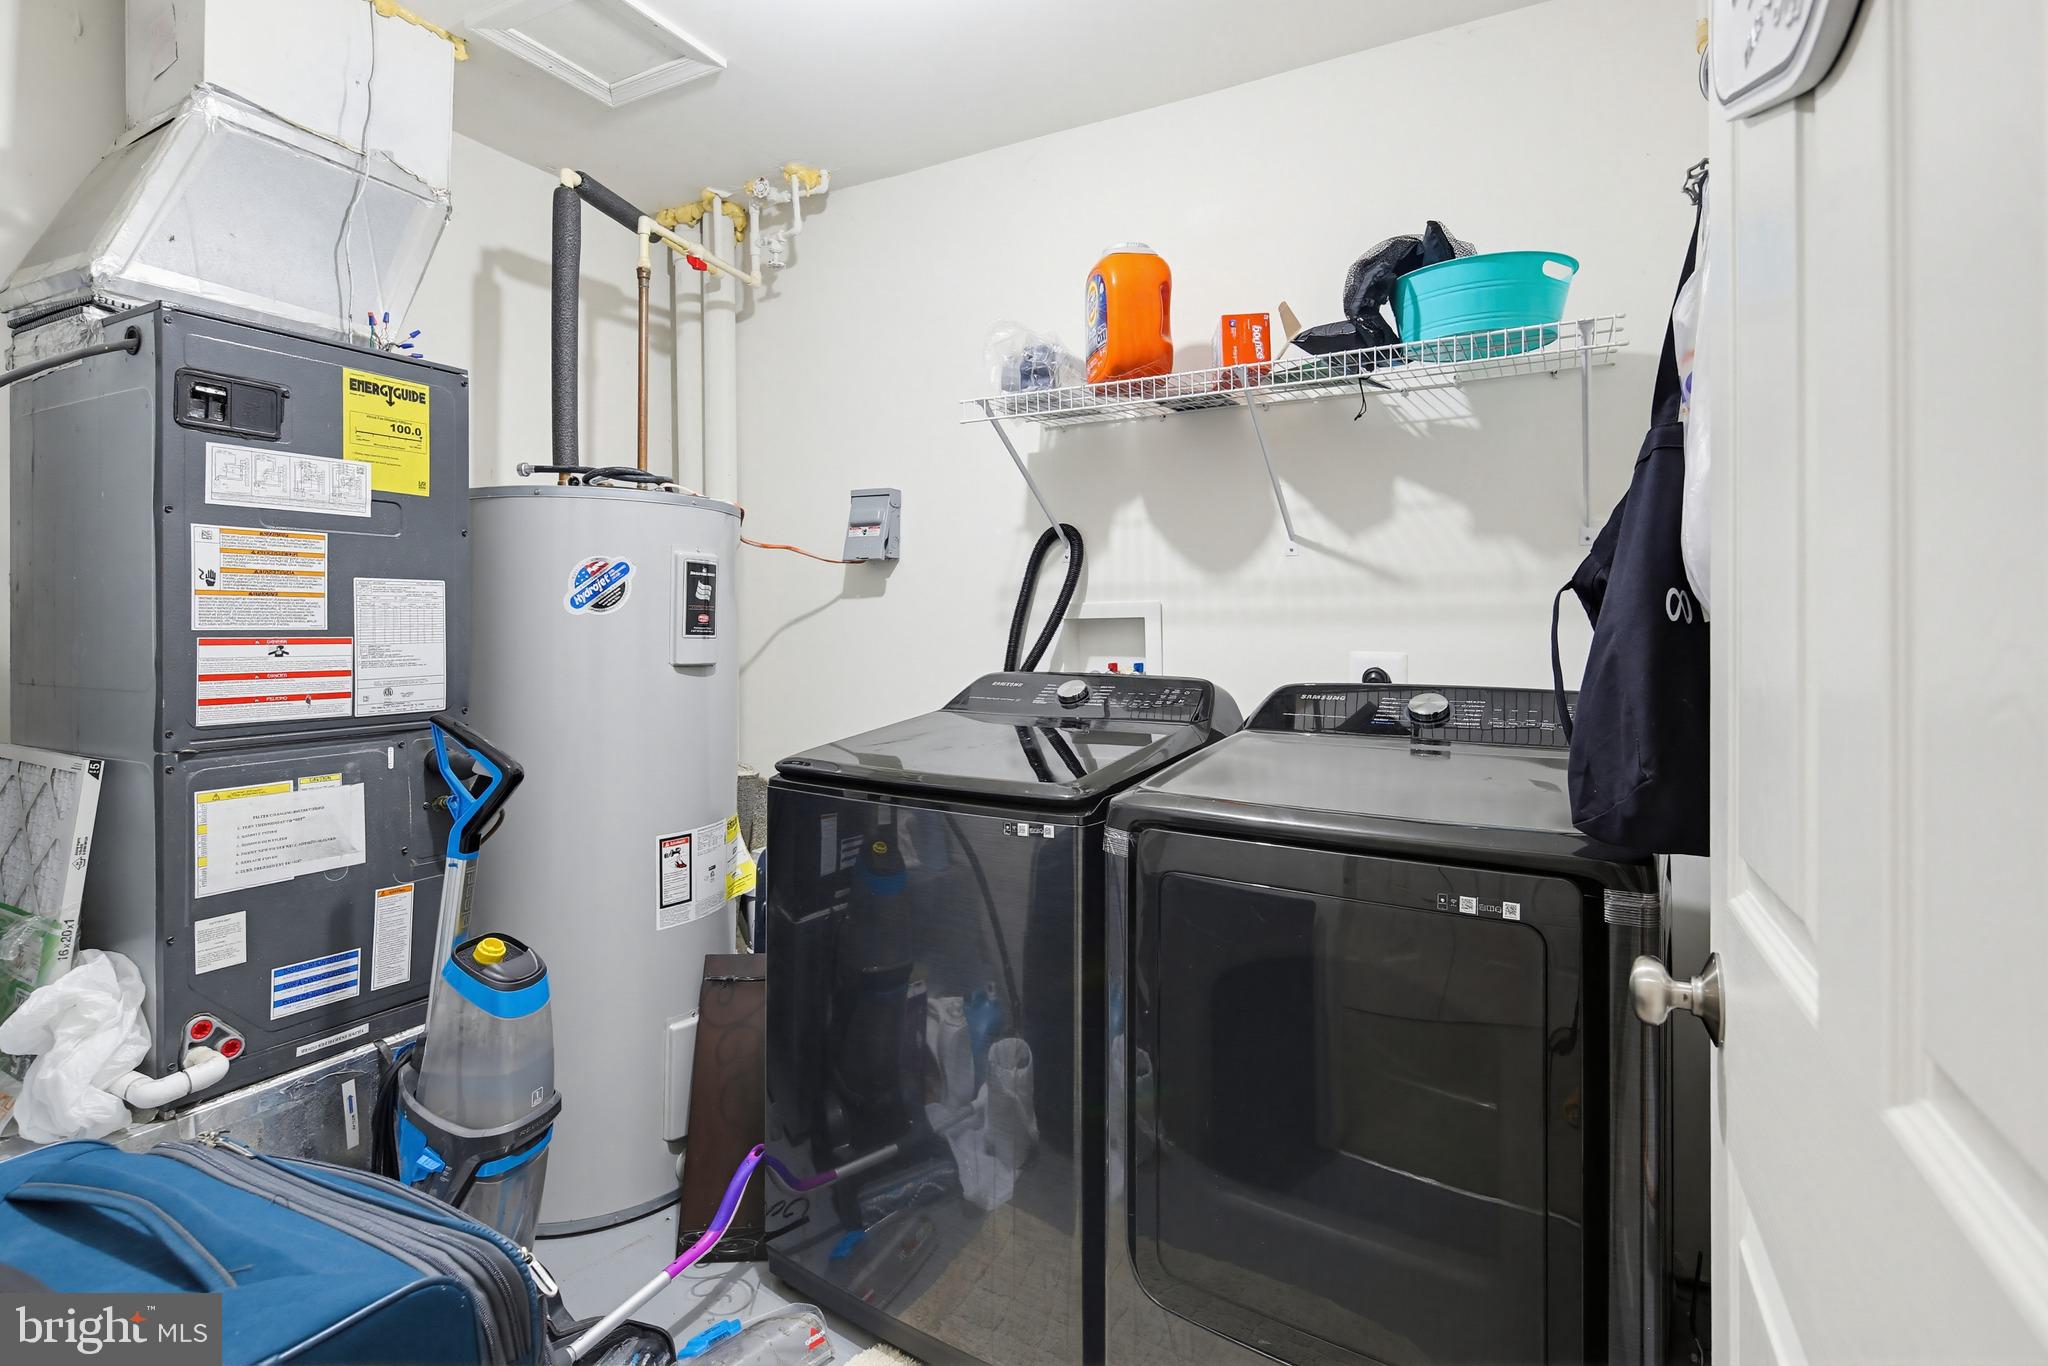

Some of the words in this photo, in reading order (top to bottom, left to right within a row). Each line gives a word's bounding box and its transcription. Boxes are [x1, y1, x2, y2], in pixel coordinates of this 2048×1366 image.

[390, 423, 422, 437] 100.0
[573, 573, 611, 606] Hydrojet
[1300, 693, 1347, 701] SAMSUNG
[57, 920, 75, 960] 16x20x1
